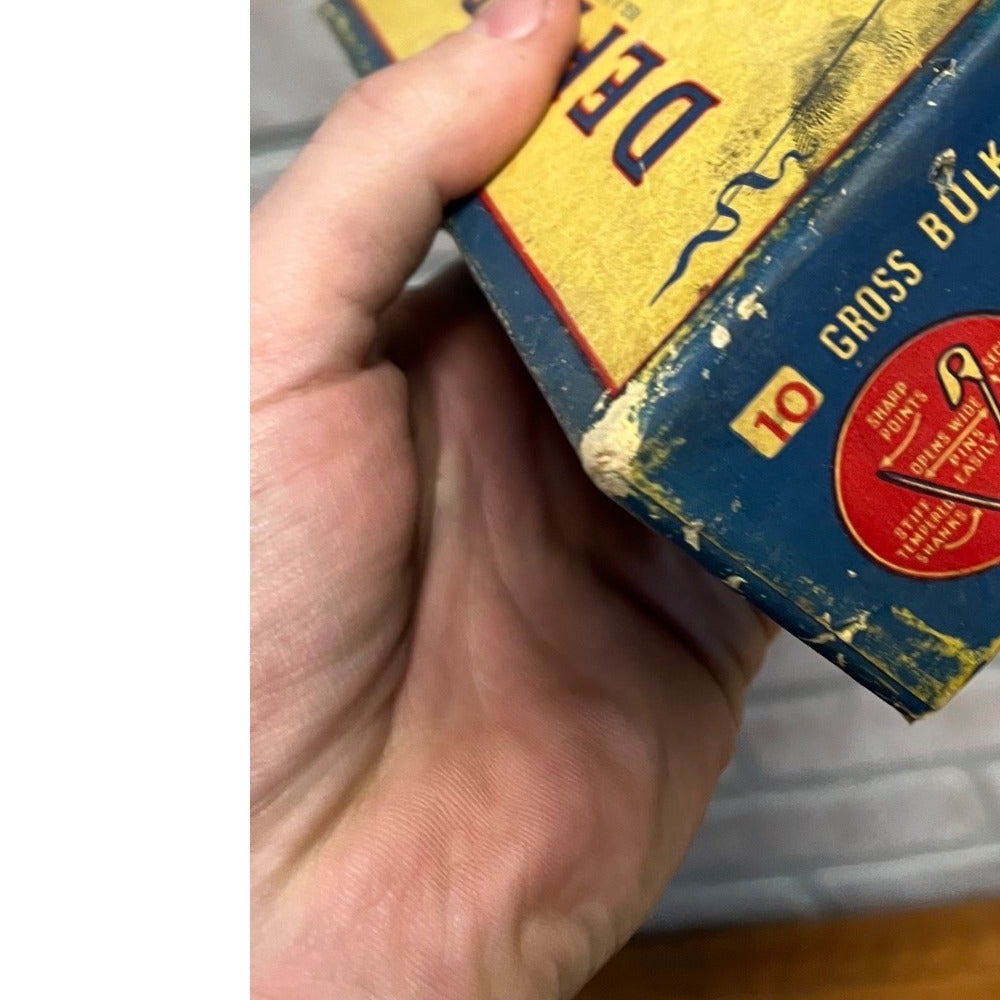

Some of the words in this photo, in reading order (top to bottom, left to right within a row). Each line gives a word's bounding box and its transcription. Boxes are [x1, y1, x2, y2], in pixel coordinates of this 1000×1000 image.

[754, 380, 818, 443] 10
[818, 249, 923, 360] GROSS
[866, 381, 908, 429] SHARP
[879, 389, 929, 442] POINTS
[910, 431, 951, 476] OPENS
[948, 395, 981, 432] WIDE
[949, 429, 986, 467] PINS
[953, 432, 999, 486] EASILY
[893, 498, 931, 541] STIFF
[896, 500, 956, 559] TEMPERED
[916, 509, 968, 564] SHANKS
